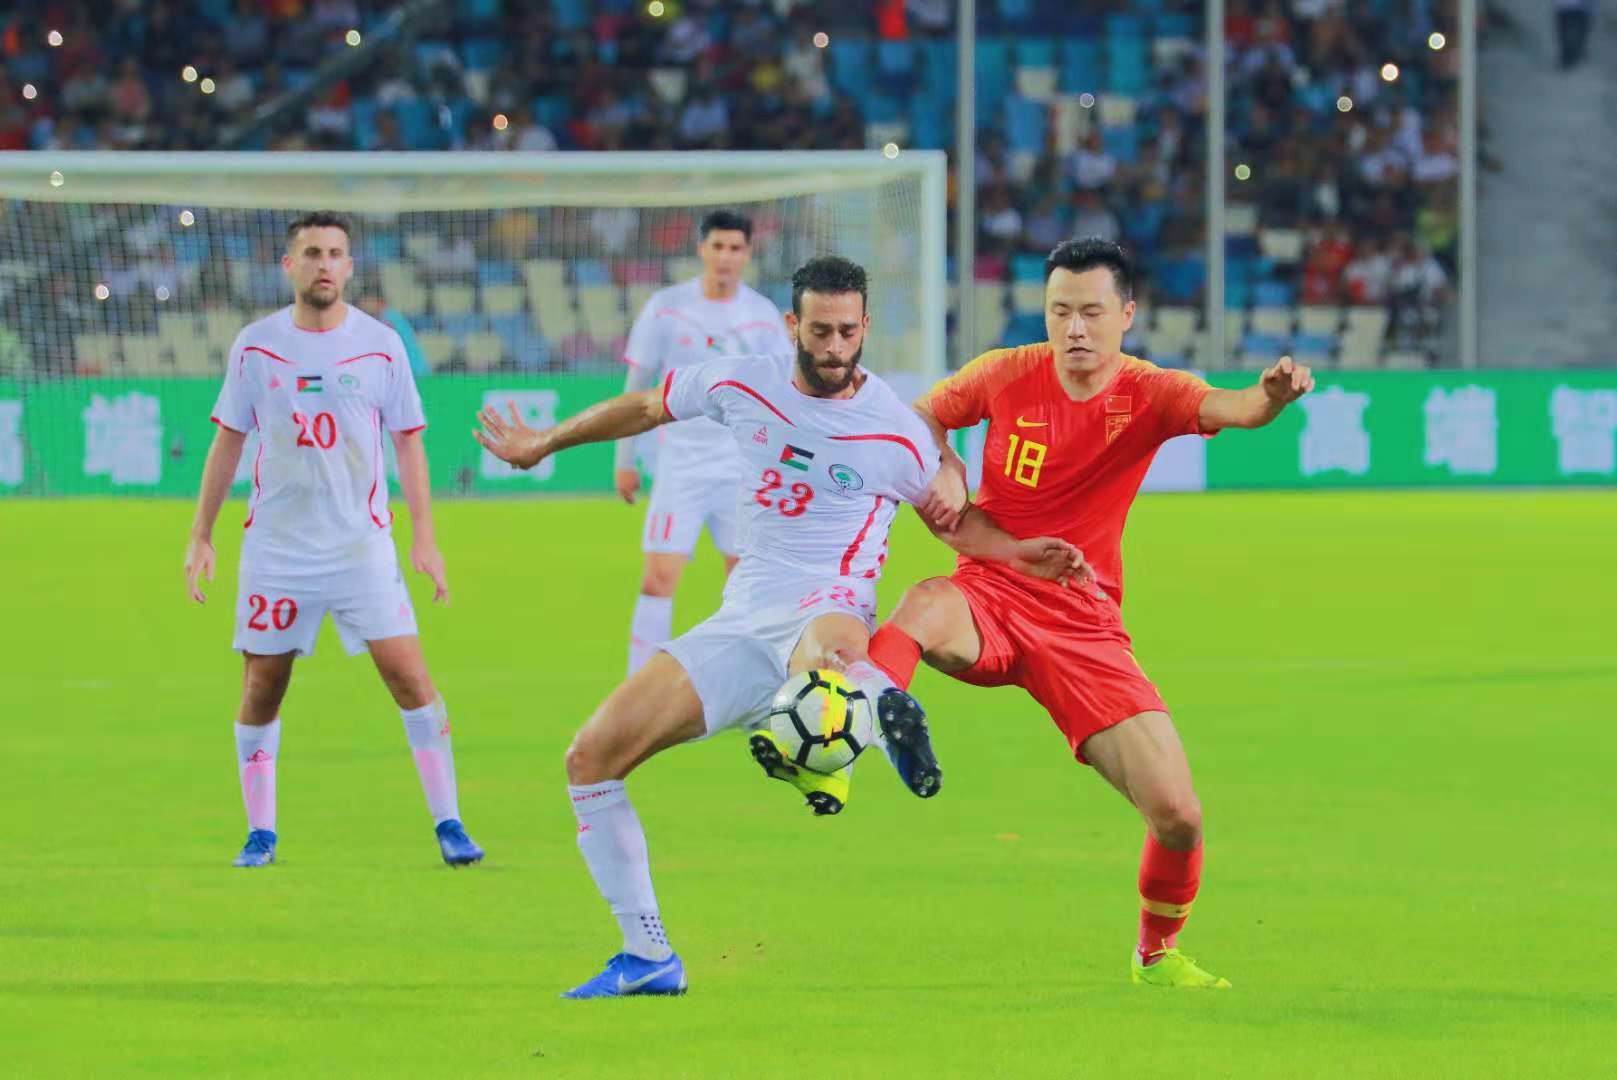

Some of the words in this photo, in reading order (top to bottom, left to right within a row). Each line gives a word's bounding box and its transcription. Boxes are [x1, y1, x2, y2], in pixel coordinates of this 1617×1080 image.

[292, 411, 337, 450] 20
[1004, 433, 1048, 489] 18
[753, 467, 815, 518] 23
[648, 513, 673, 541] 11
[247, 593, 298, 632] 20
